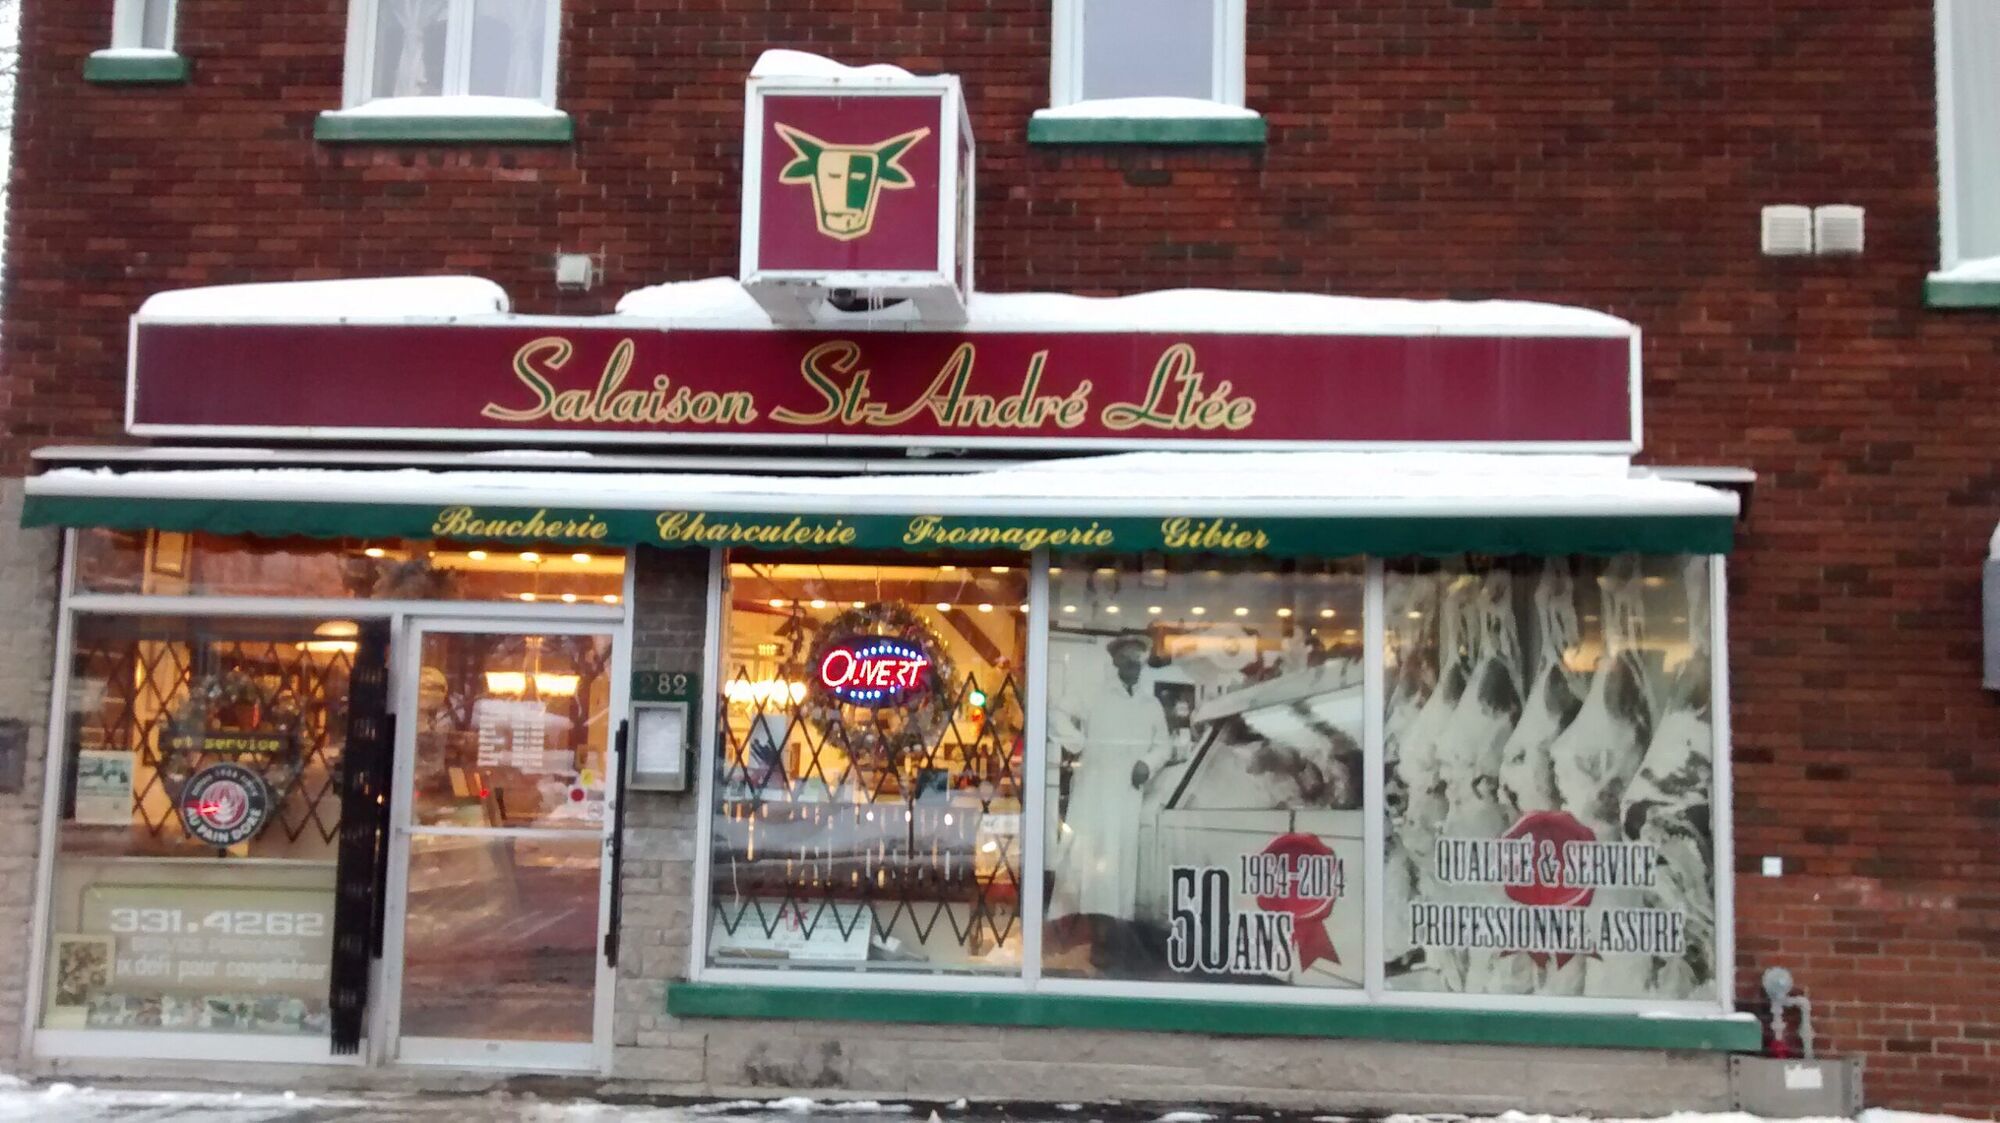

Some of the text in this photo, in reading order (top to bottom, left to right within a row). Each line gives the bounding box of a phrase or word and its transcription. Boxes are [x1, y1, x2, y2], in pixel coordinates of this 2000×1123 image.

[481, 337, 1256, 430] Salaison St-André Ltée
[432, 507, 1270, 551] Boucherie Charcuterie Fromagerie Gibier
[204, 738, 280, 751] service
[197, 824, 229, 843] PAIN
[1241, 855, 1345, 897] 1964-2014
[1437, 833, 1656, 887] QUALITÉ & SERVICE
[110, 908, 325, 936] 331.4262
[1169, 867, 1291, 972] 50 ANS
[1411, 904, 1592, 951] PROFESSIONNEL
[178, 959, 218, 984] pour
